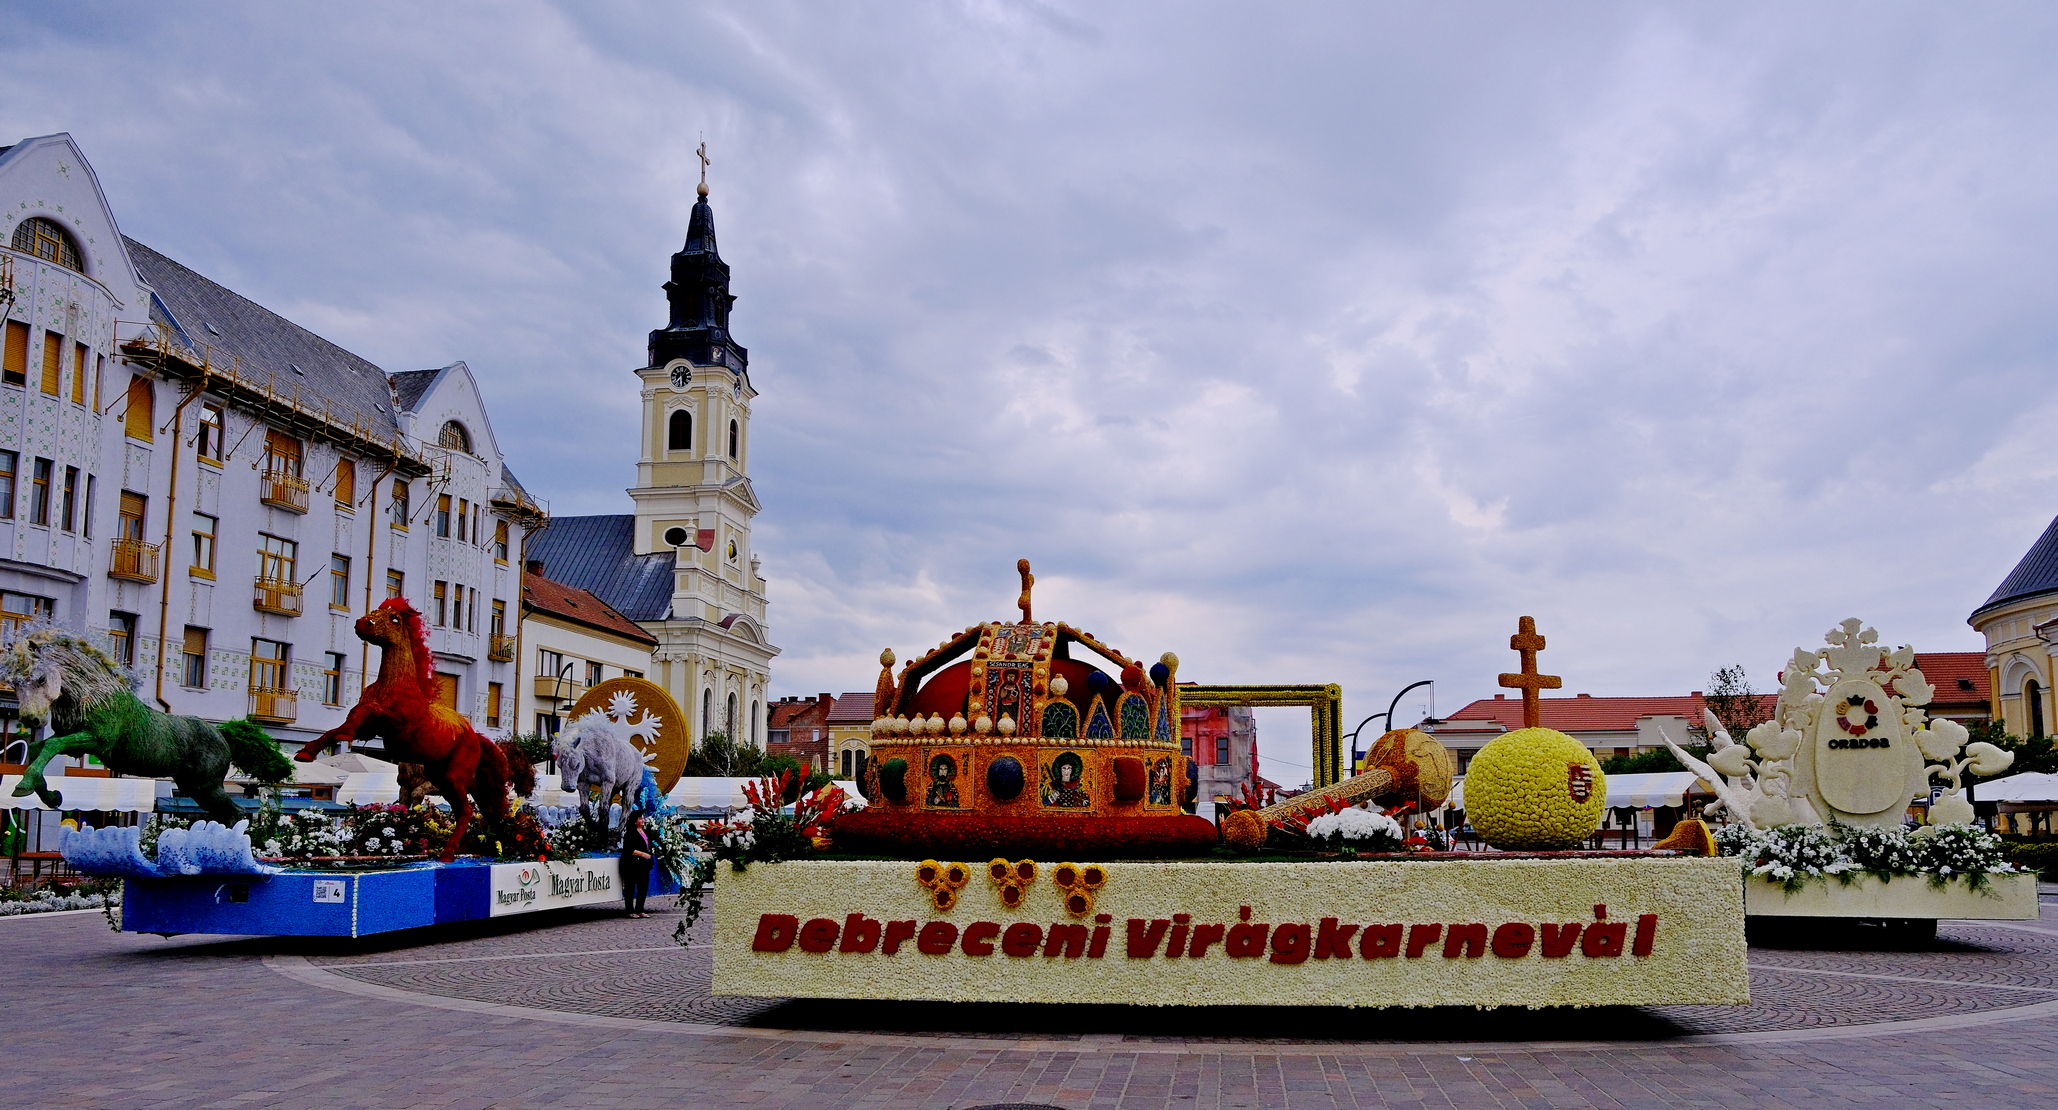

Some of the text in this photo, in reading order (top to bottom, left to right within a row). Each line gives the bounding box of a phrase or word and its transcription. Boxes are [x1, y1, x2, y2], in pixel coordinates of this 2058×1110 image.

[333, 888, 341, 898] 4
[549, 870, 611, 898] Magyar Posta
[497, 887, 536, 905] Magyar Posta
[752, 912, 1112, 959] Debreceni
